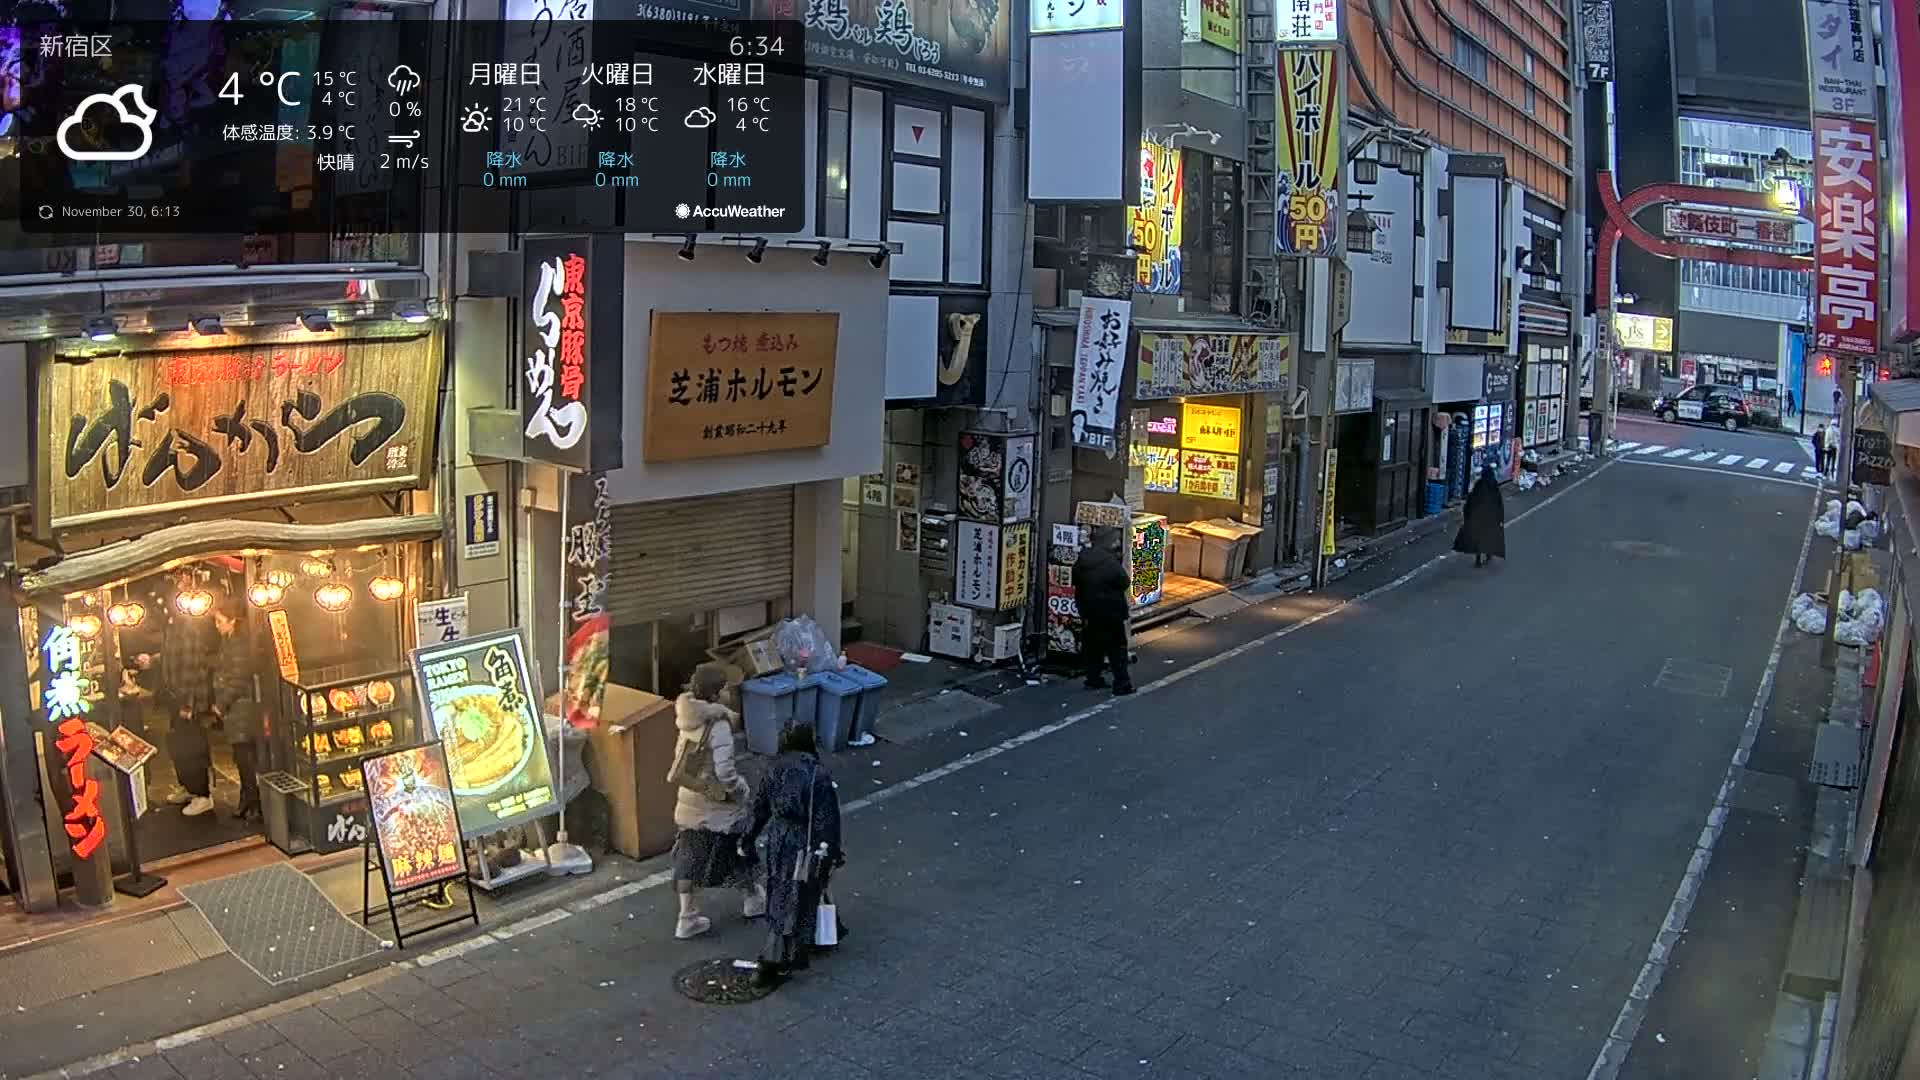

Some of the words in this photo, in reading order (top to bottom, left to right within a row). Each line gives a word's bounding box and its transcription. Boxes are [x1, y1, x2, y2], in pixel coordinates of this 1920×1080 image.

[1294, 52, 1321, 190] ハイボール
[1588, 63, 1609, 78] 7F
[1160, 152, 1175, 288] ハイボール
[1820, 126, 1875, 330] 安楽亭
[560, 253, 587, 400] 東京豚骨
[1094, 308, 1122, 414] お好み焼き
[1818, 332, 1836, 348] 2F
[65, 378, 406, 492] ばんから
[667, 366, 824, 406] 芝浦ホルモン
